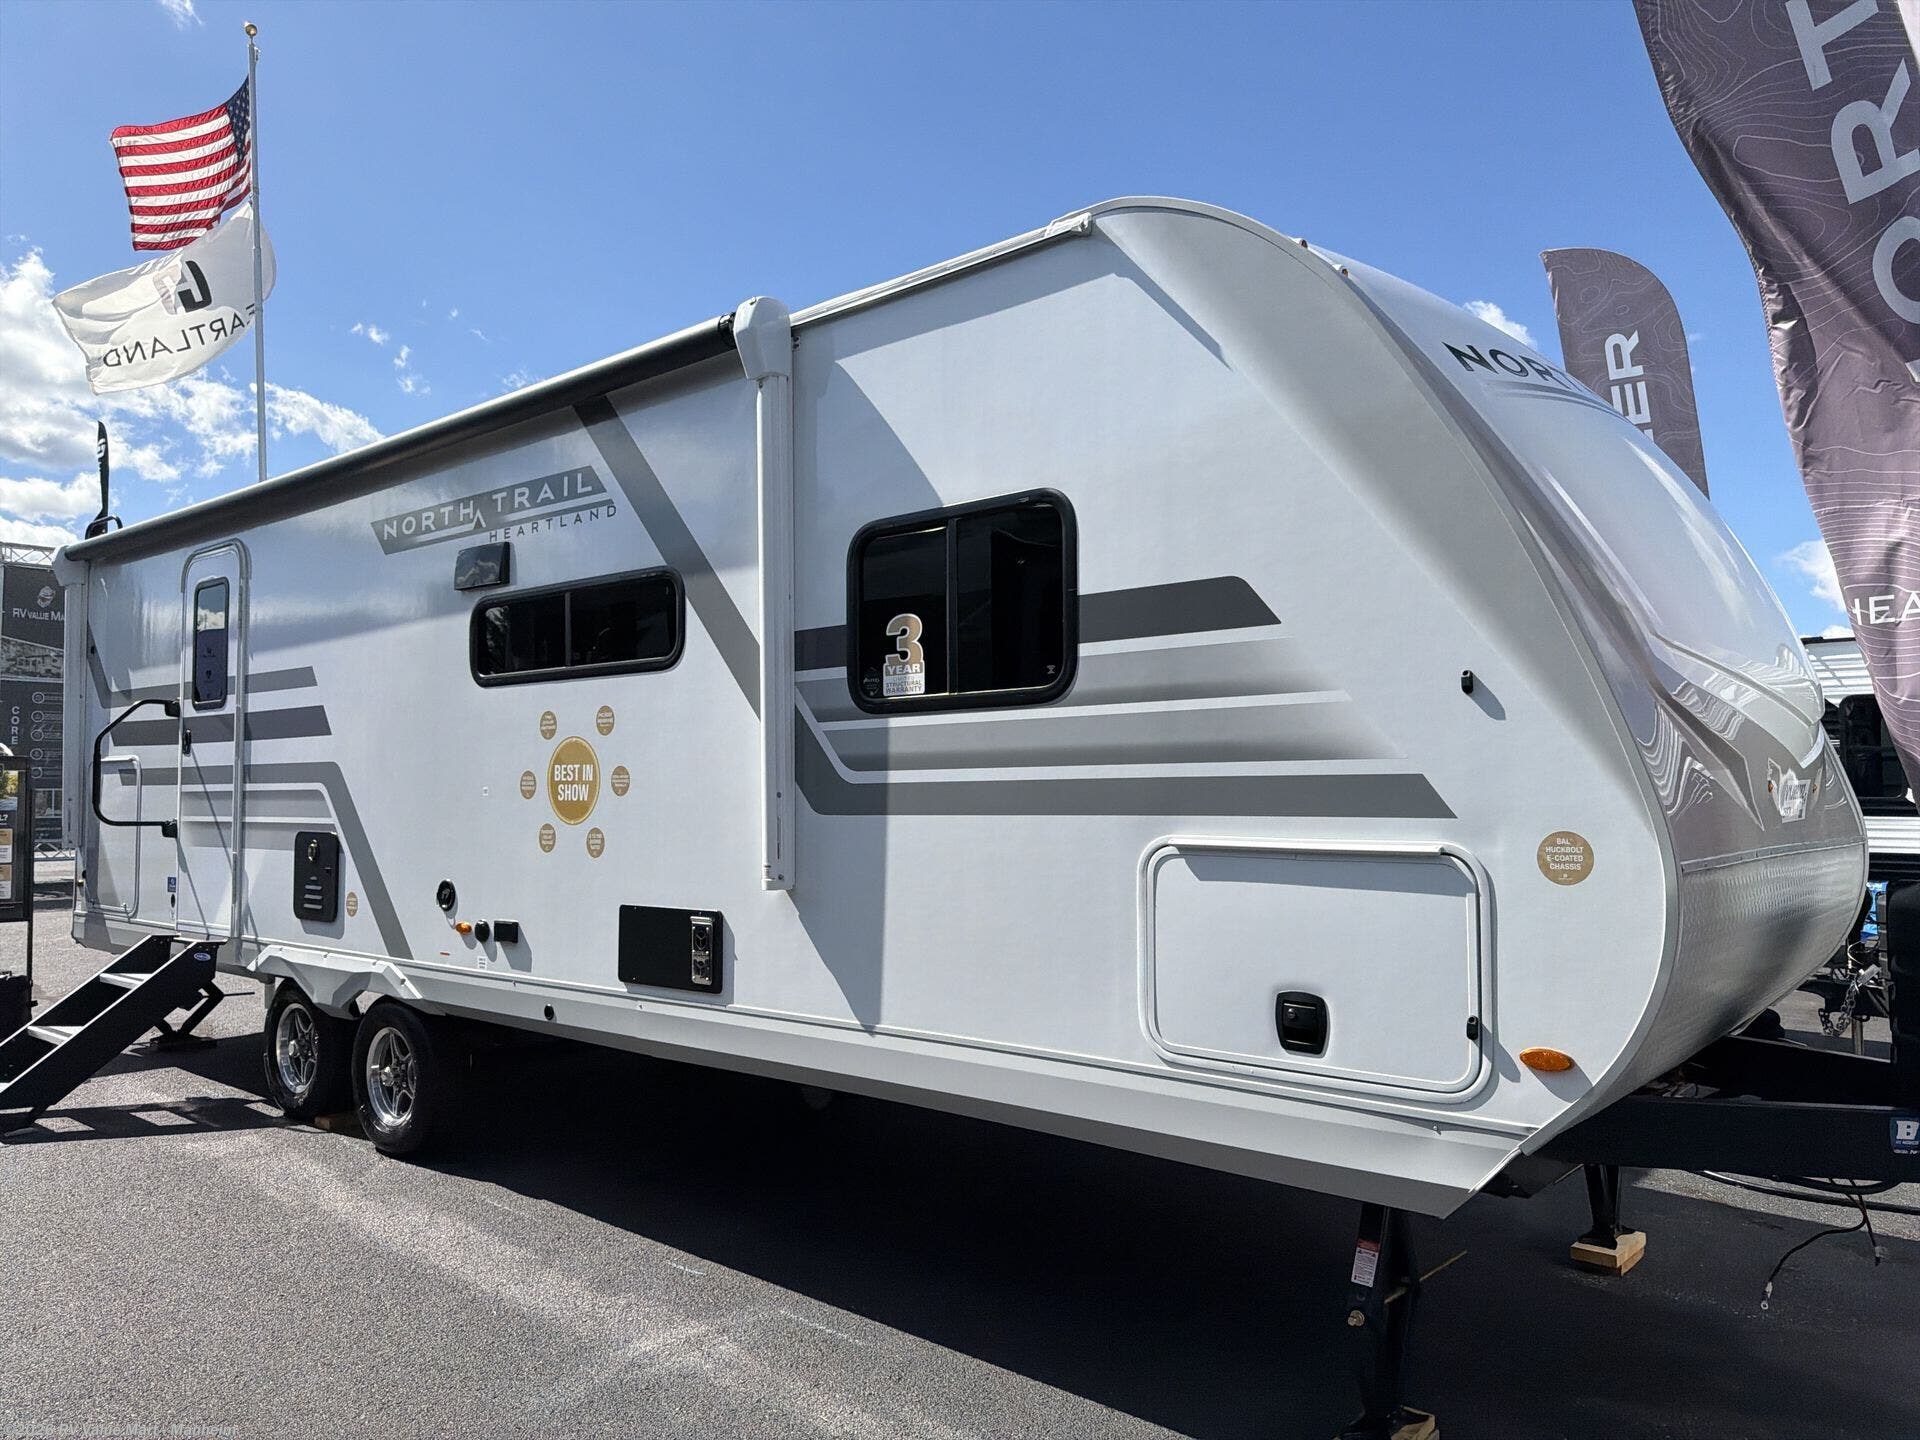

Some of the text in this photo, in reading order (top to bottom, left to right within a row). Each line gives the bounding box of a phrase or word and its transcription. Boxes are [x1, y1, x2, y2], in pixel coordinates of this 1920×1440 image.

[1605, 330, 1654, 441] ER
[383, 472, 593, 541] NORTH TRAIL
[489, 505, 617, 542] HEARTLAND
[12, 607, 27, 619] RV
[27, 611, 49, 621] VALUE
[1852, 591, 1920, 625] HEA
[886, 613, 924, 664] 3
[887, 663, 921, 675] YEAR
[885, 680, 922, 689] STRUCTURAL
[885, 685, 922, 695] WARRANTY
[11, 705, 20, 745] CORE
[554, 764, 580, 781] BEST
[582, 764, 593, 781] IN
[557, 783, 589, 801] SHOW
[1546, 854, 1584, 862] E-COATED
